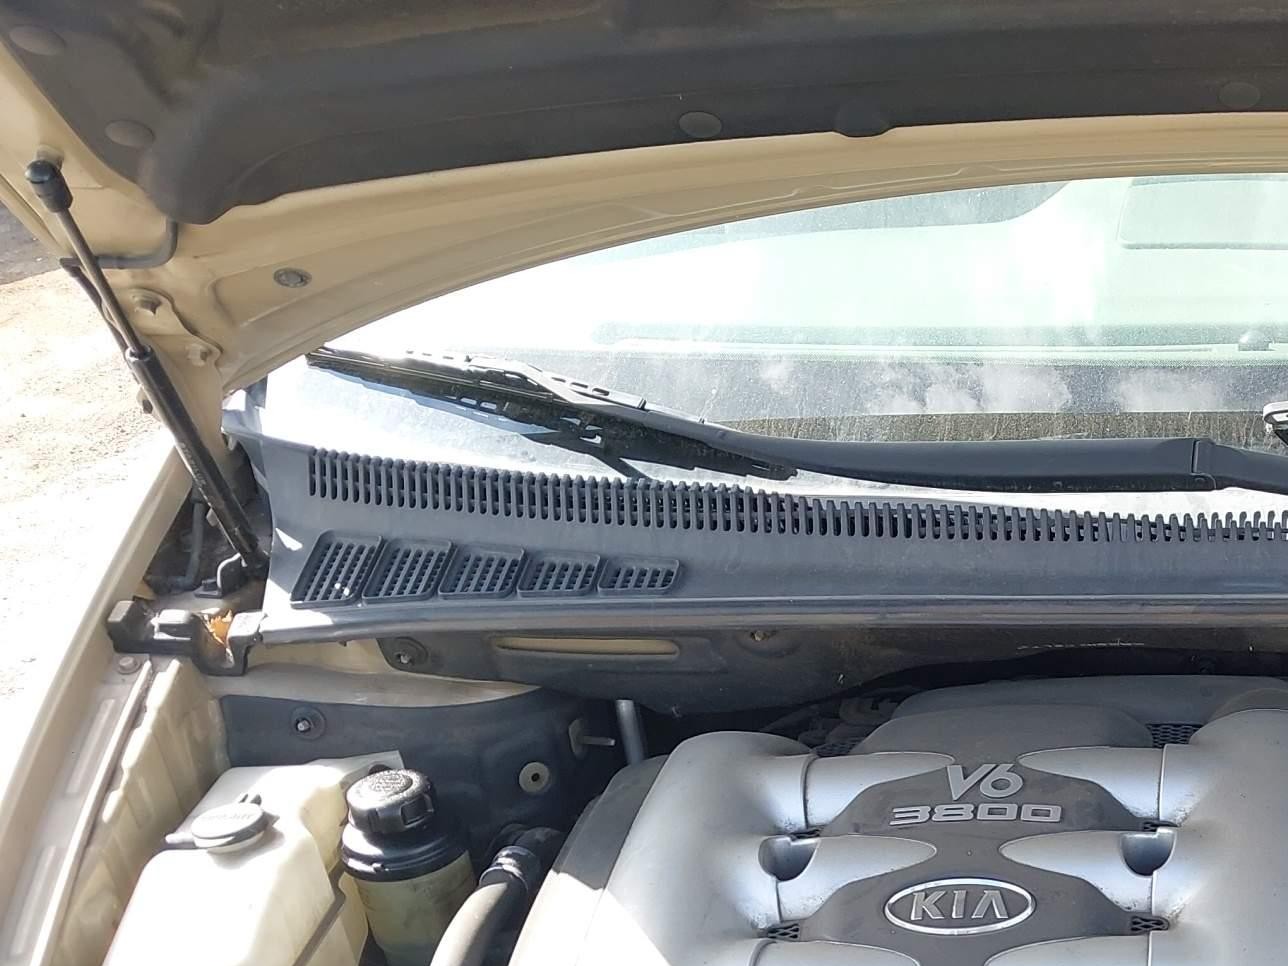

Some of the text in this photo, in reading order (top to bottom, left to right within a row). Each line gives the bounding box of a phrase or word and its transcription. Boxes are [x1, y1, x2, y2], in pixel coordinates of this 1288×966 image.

[946, 763, 1024, 801] V6
[889, 803, 1063, 826] 3800
[910, 890, 1010, 921] KIA
